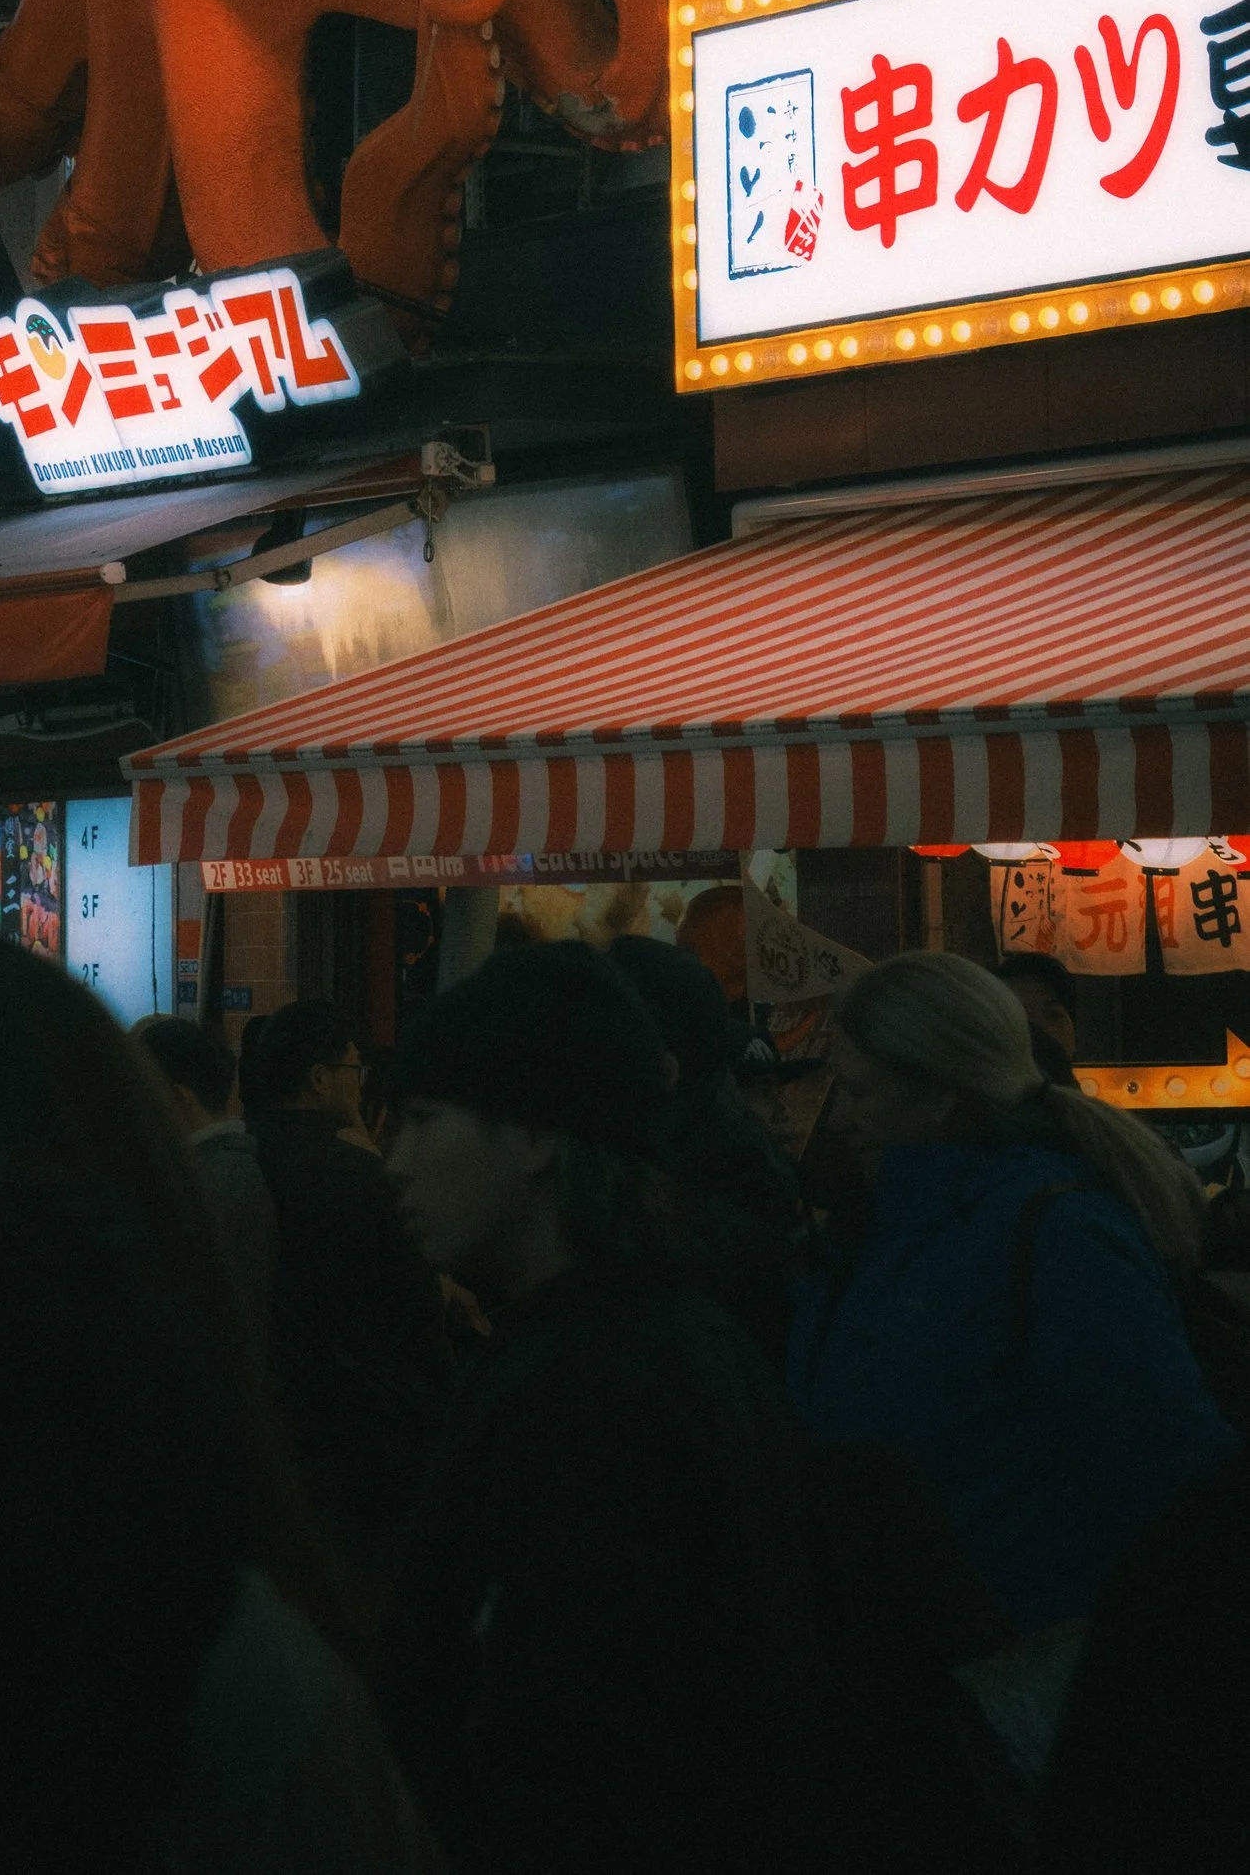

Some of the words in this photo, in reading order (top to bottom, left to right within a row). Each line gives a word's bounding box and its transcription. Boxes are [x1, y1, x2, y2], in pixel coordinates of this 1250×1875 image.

[34, 454, 90, 482] Dotonbori
[90, 448, 135, 475] KUKURU
[137, 434, 247, 468] Konamon-Museum
[80, 826, 100, 850] 4F
[213, 863, 228, 888] 2F
[234, 862, 254, 887] 33
[254, 863, 283, 886] seat
[299, 860, 315, 885] 3F
[323, 860, 343, 885] 25
[345, 862, 375, 884] seat
[81, 894, 100, 919] 3F
